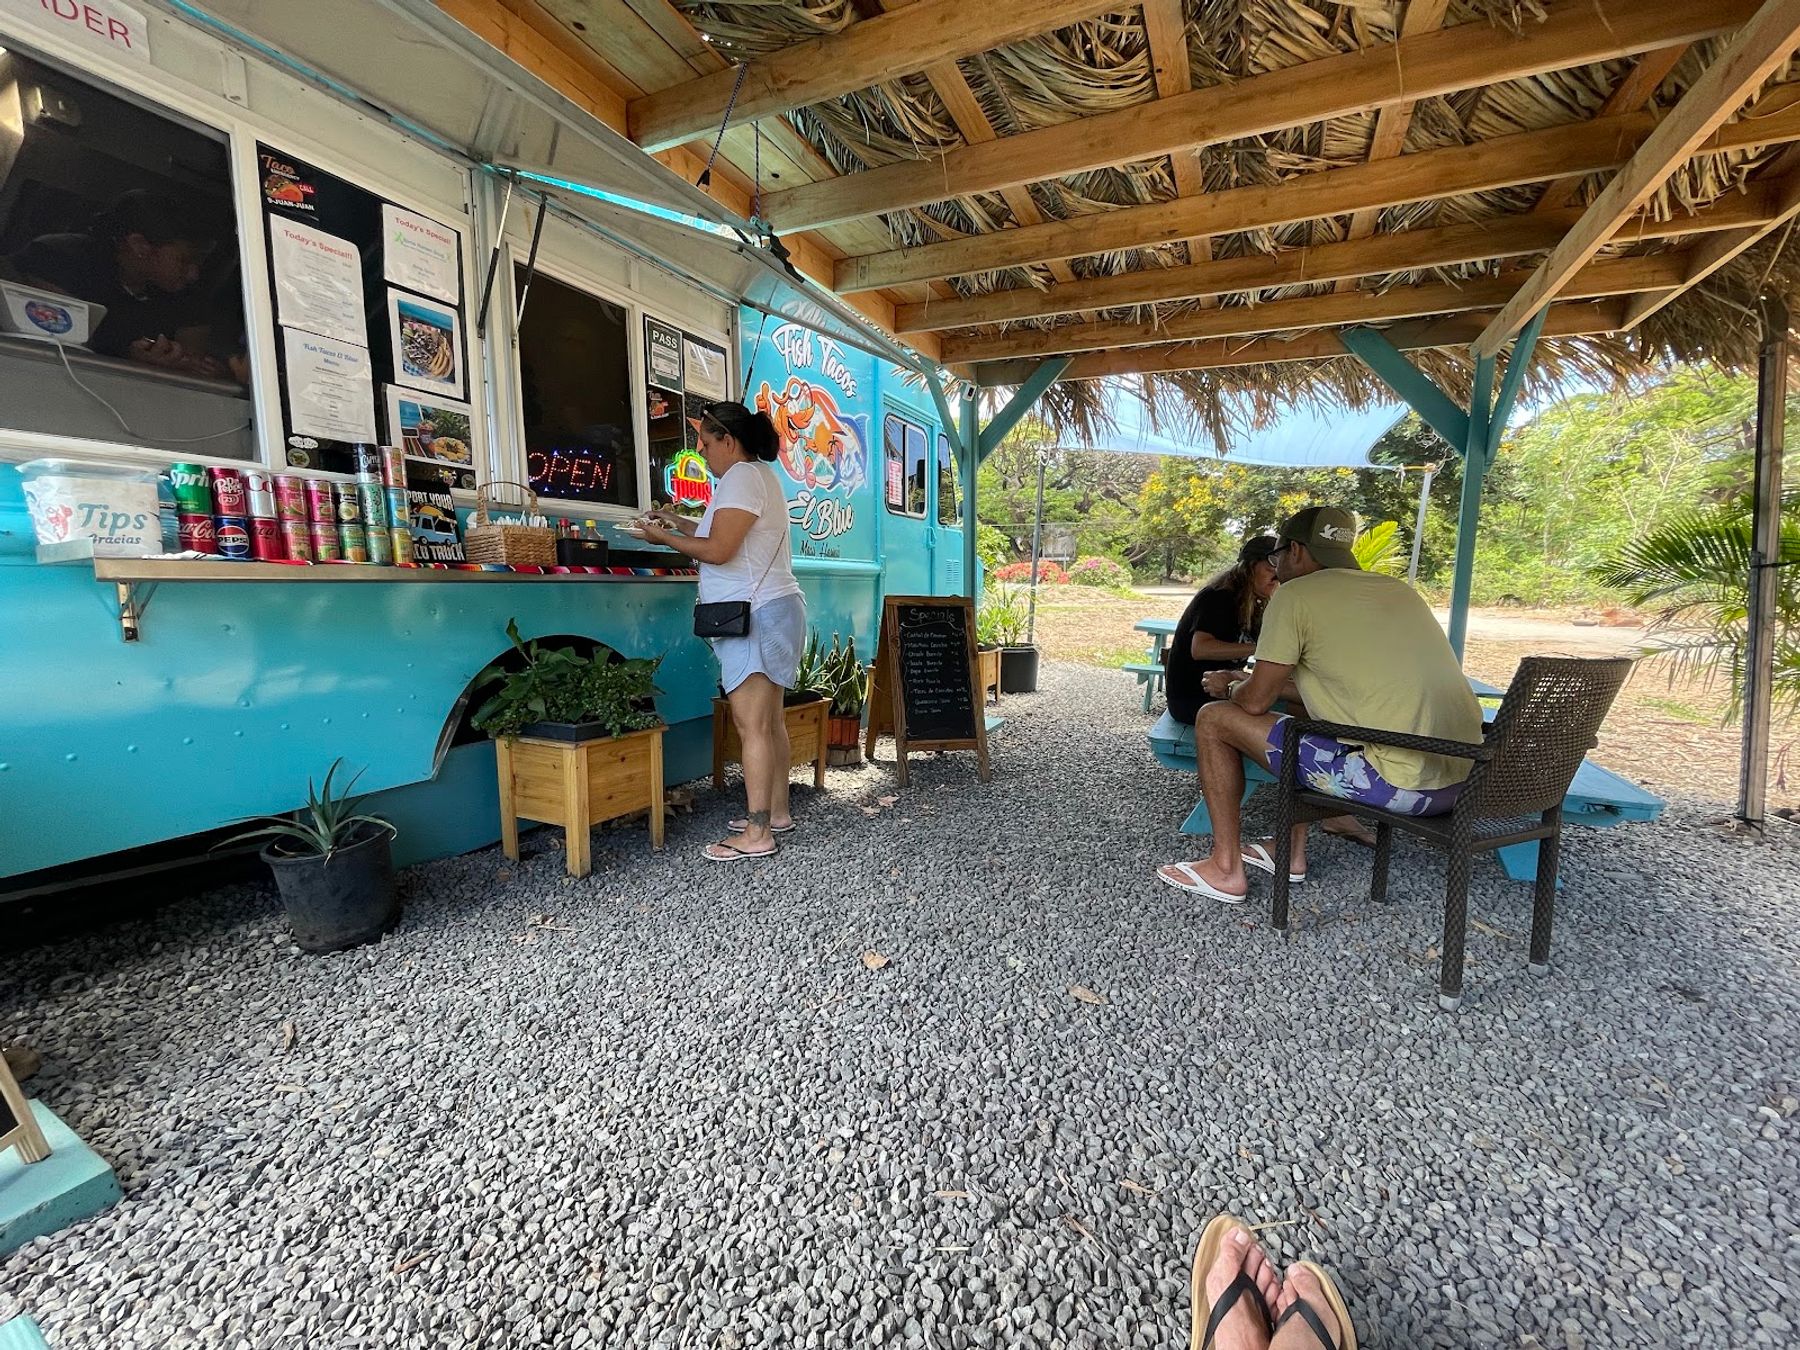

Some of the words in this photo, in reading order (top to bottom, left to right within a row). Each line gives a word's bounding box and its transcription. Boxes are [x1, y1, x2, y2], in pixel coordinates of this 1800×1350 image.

[41, 0, 132, 49] DER
[283, 229, 318, 247] Today's
[395, 216, 425, 234] Today's
[652, 329, 678, 349] PASS
[771, 322, 815, 376] Fish
[816, 334, 858, 399] Tacos
[528, 452, 612, 490] OPEN
[428, 490, 455, 512] YOUR
[671, 477, 713, 507] TACOS
[77, 503, 148, 537] Tips
[786, 489, 817, 532] El
[809, 499, 854, 541] Blue
[430, 542, 466, 562] TRUCK
[908, 608, 956, 625] Specials
